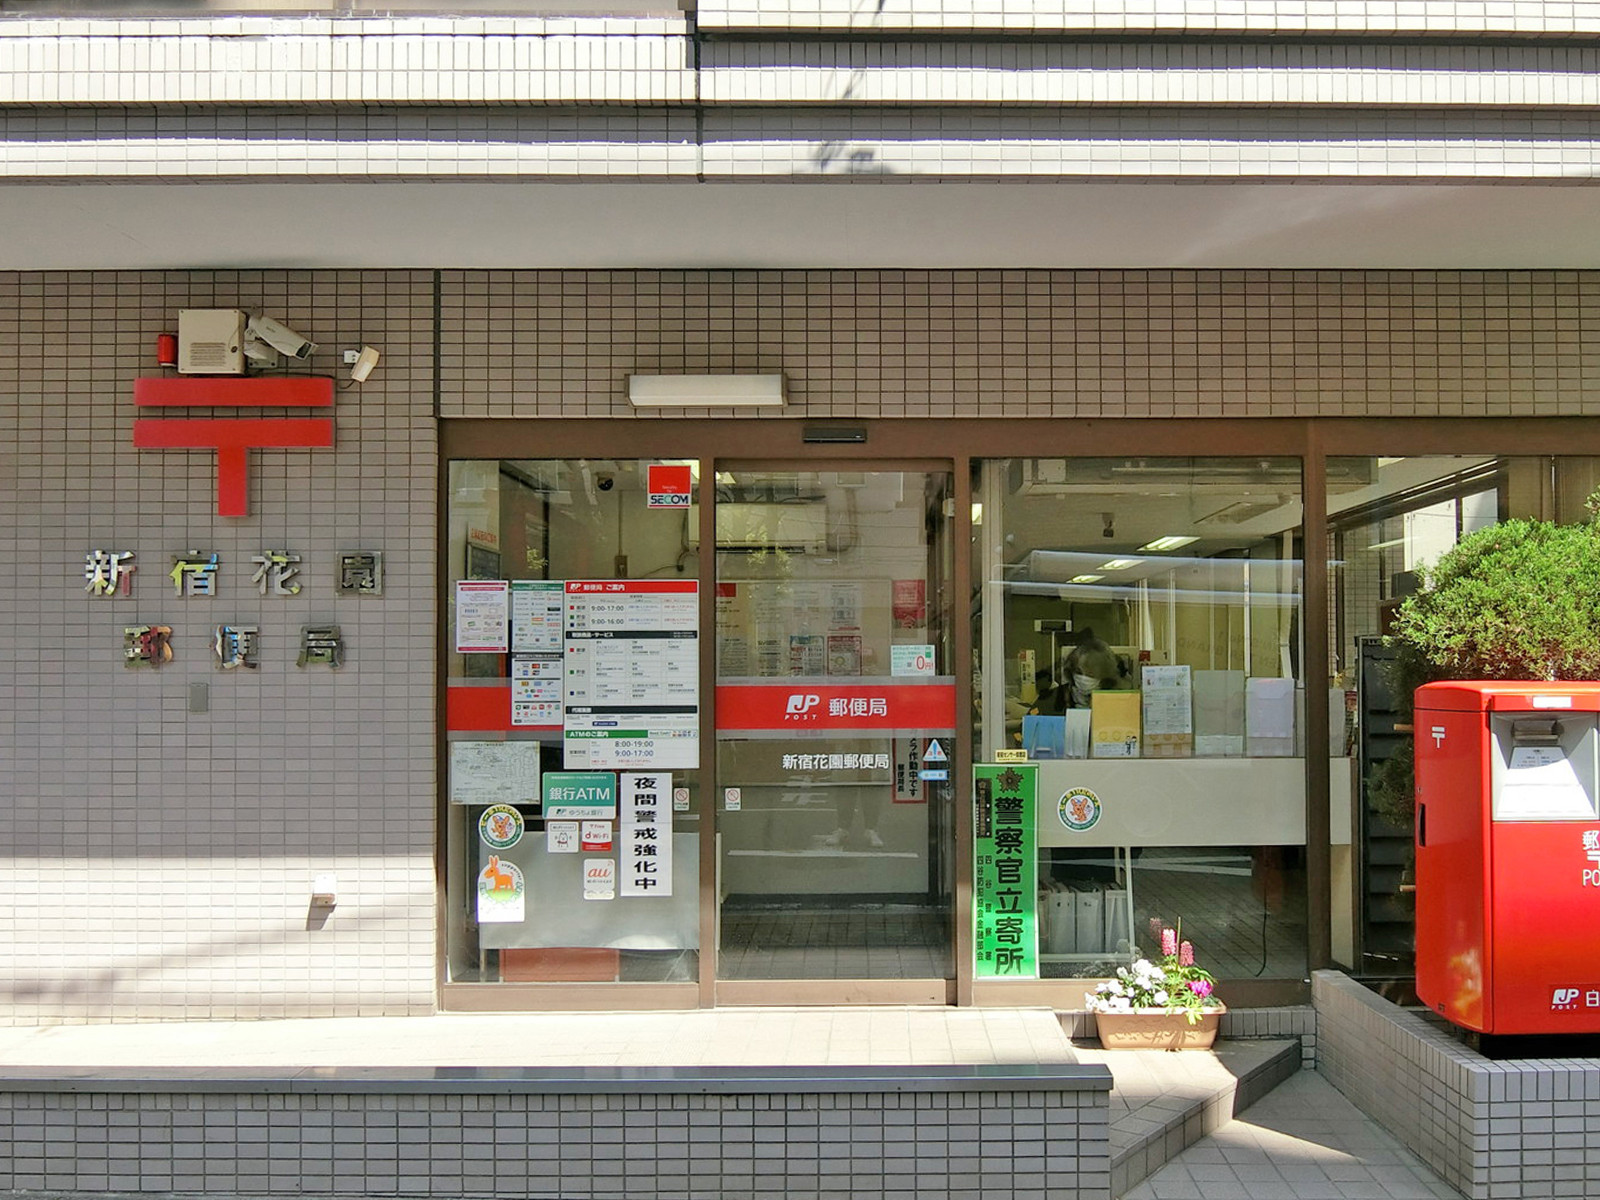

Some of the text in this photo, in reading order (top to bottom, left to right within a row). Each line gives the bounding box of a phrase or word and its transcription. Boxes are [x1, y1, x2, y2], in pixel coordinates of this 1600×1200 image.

[651, 494, 689, 504] SECOM
[85, 549, 384, 596] 新宿花園
[124, 625, 345, 670] 郵便局
[829, 698, 888, 717] 郵便局
[615, 740, 654, 748] 8:00-19:00
[782, 754, 890, 770] 新宿花園郵便局
[549, 787, 610, 801] 銀行ATM
[634, 777, 657, 889] 夜間警戒強化中
[588, 868, 612, 878] au
[995, 797, 1024, 975] 警察官立寄所
